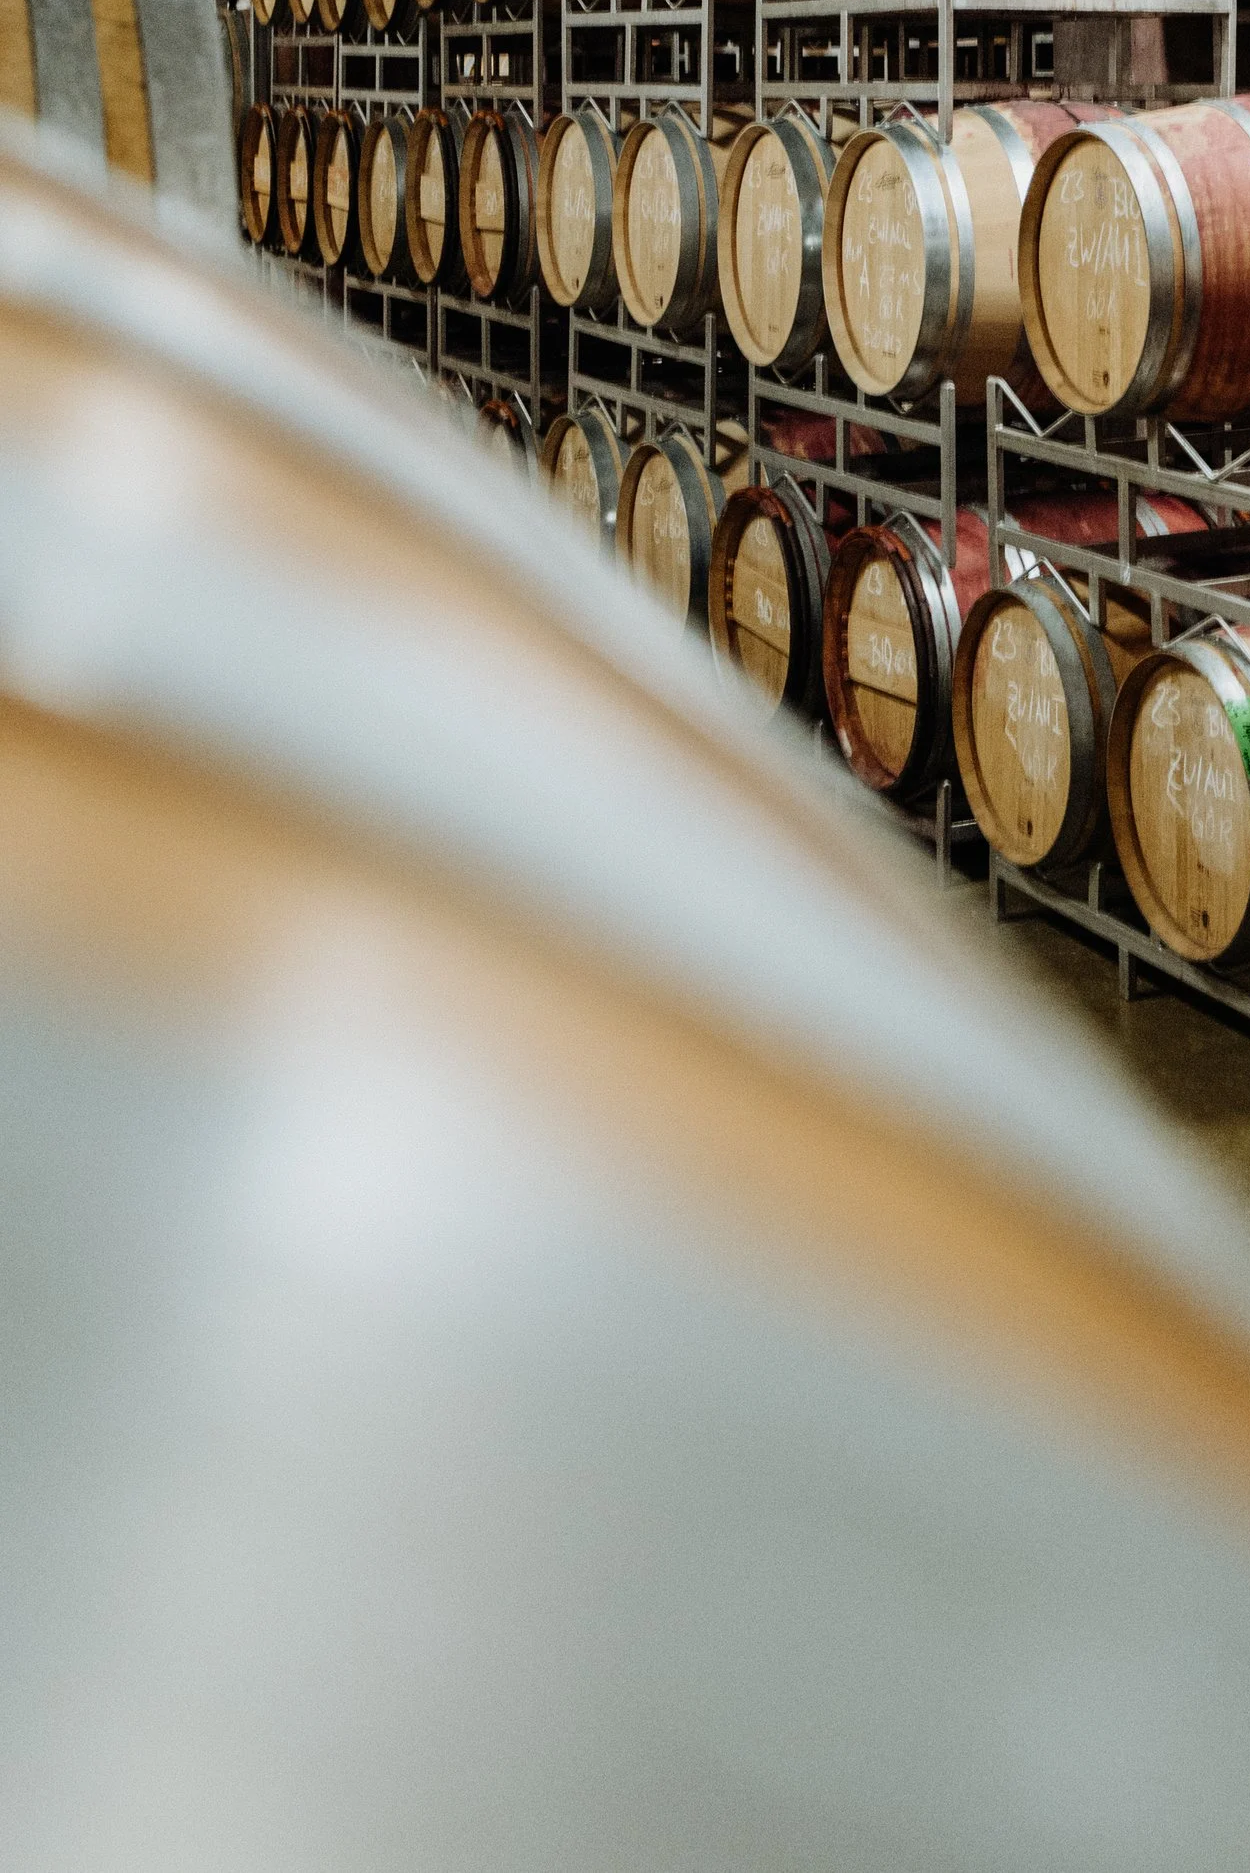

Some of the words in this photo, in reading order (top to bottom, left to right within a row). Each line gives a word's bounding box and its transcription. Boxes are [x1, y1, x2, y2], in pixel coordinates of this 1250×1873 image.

[1060, 169, 1084, 204] 23
[991, 617, 1017, 663] 23
[1151, 681, 1181, 729] 23
